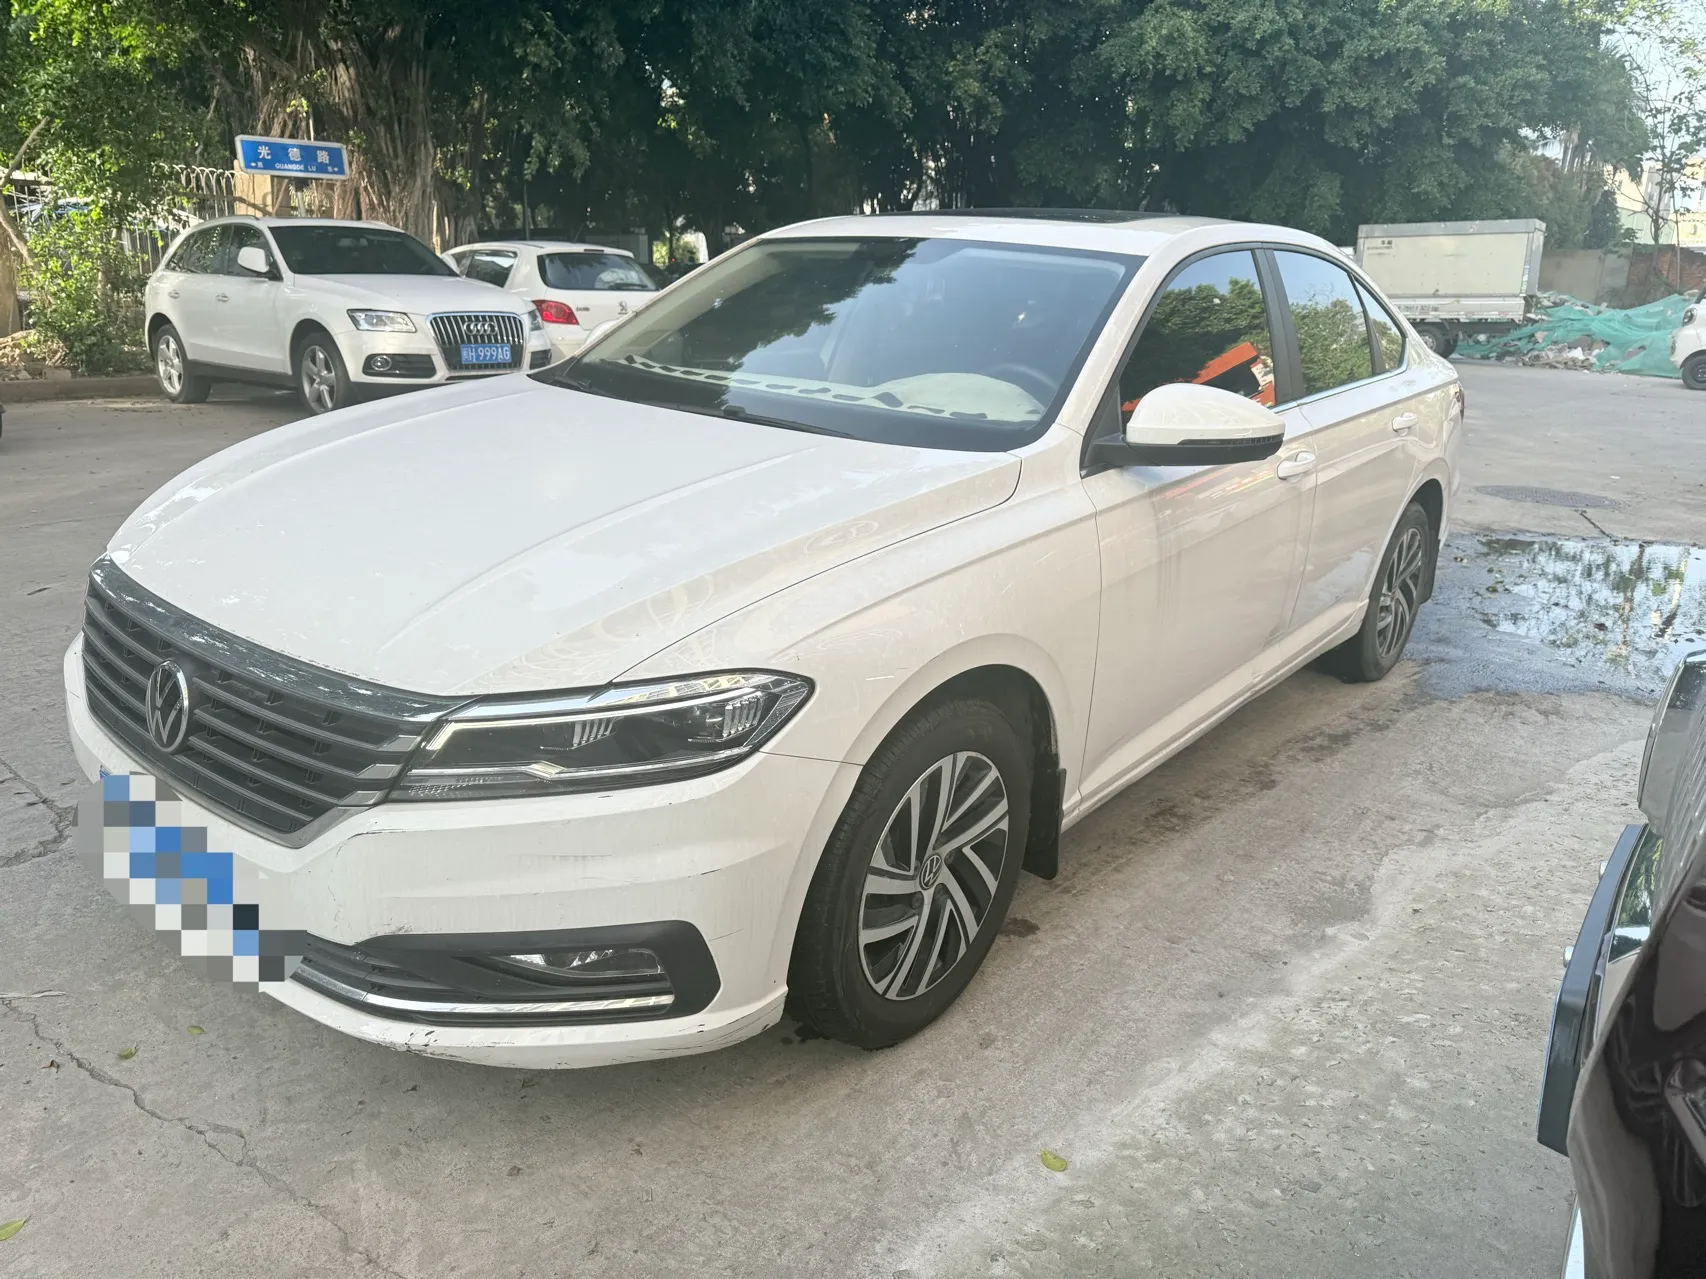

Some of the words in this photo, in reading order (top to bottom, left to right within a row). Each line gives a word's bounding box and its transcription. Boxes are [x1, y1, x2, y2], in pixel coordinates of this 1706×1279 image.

[258, 145, 330, 164] 光德路
[275, 162, 305, 171] GUANGDE
